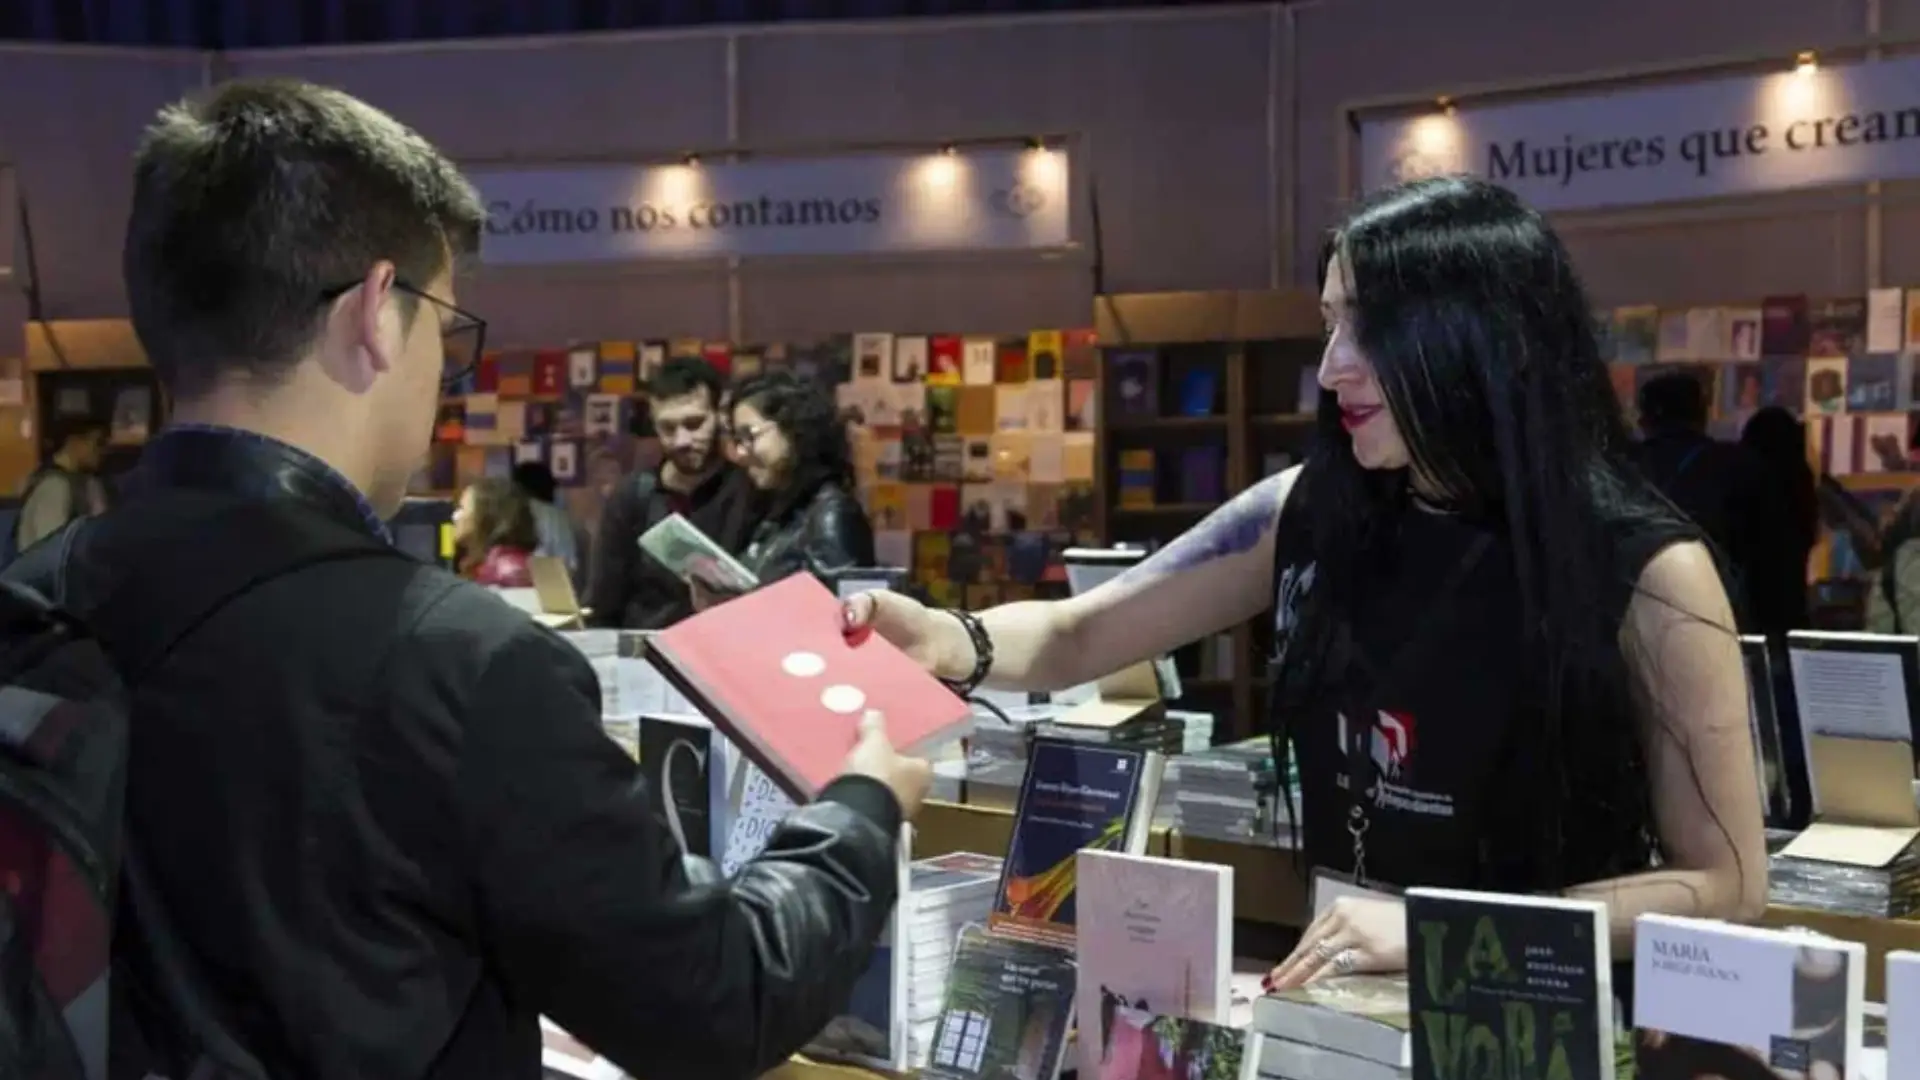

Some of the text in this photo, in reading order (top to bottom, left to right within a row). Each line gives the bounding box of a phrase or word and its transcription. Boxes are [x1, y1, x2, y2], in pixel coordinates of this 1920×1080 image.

[1486, 106, 1920, 187] Mujeres que crean
[485, 193, 880, 236] Cómo nos contamos
[1418, 915, 1516, 1006] LA
